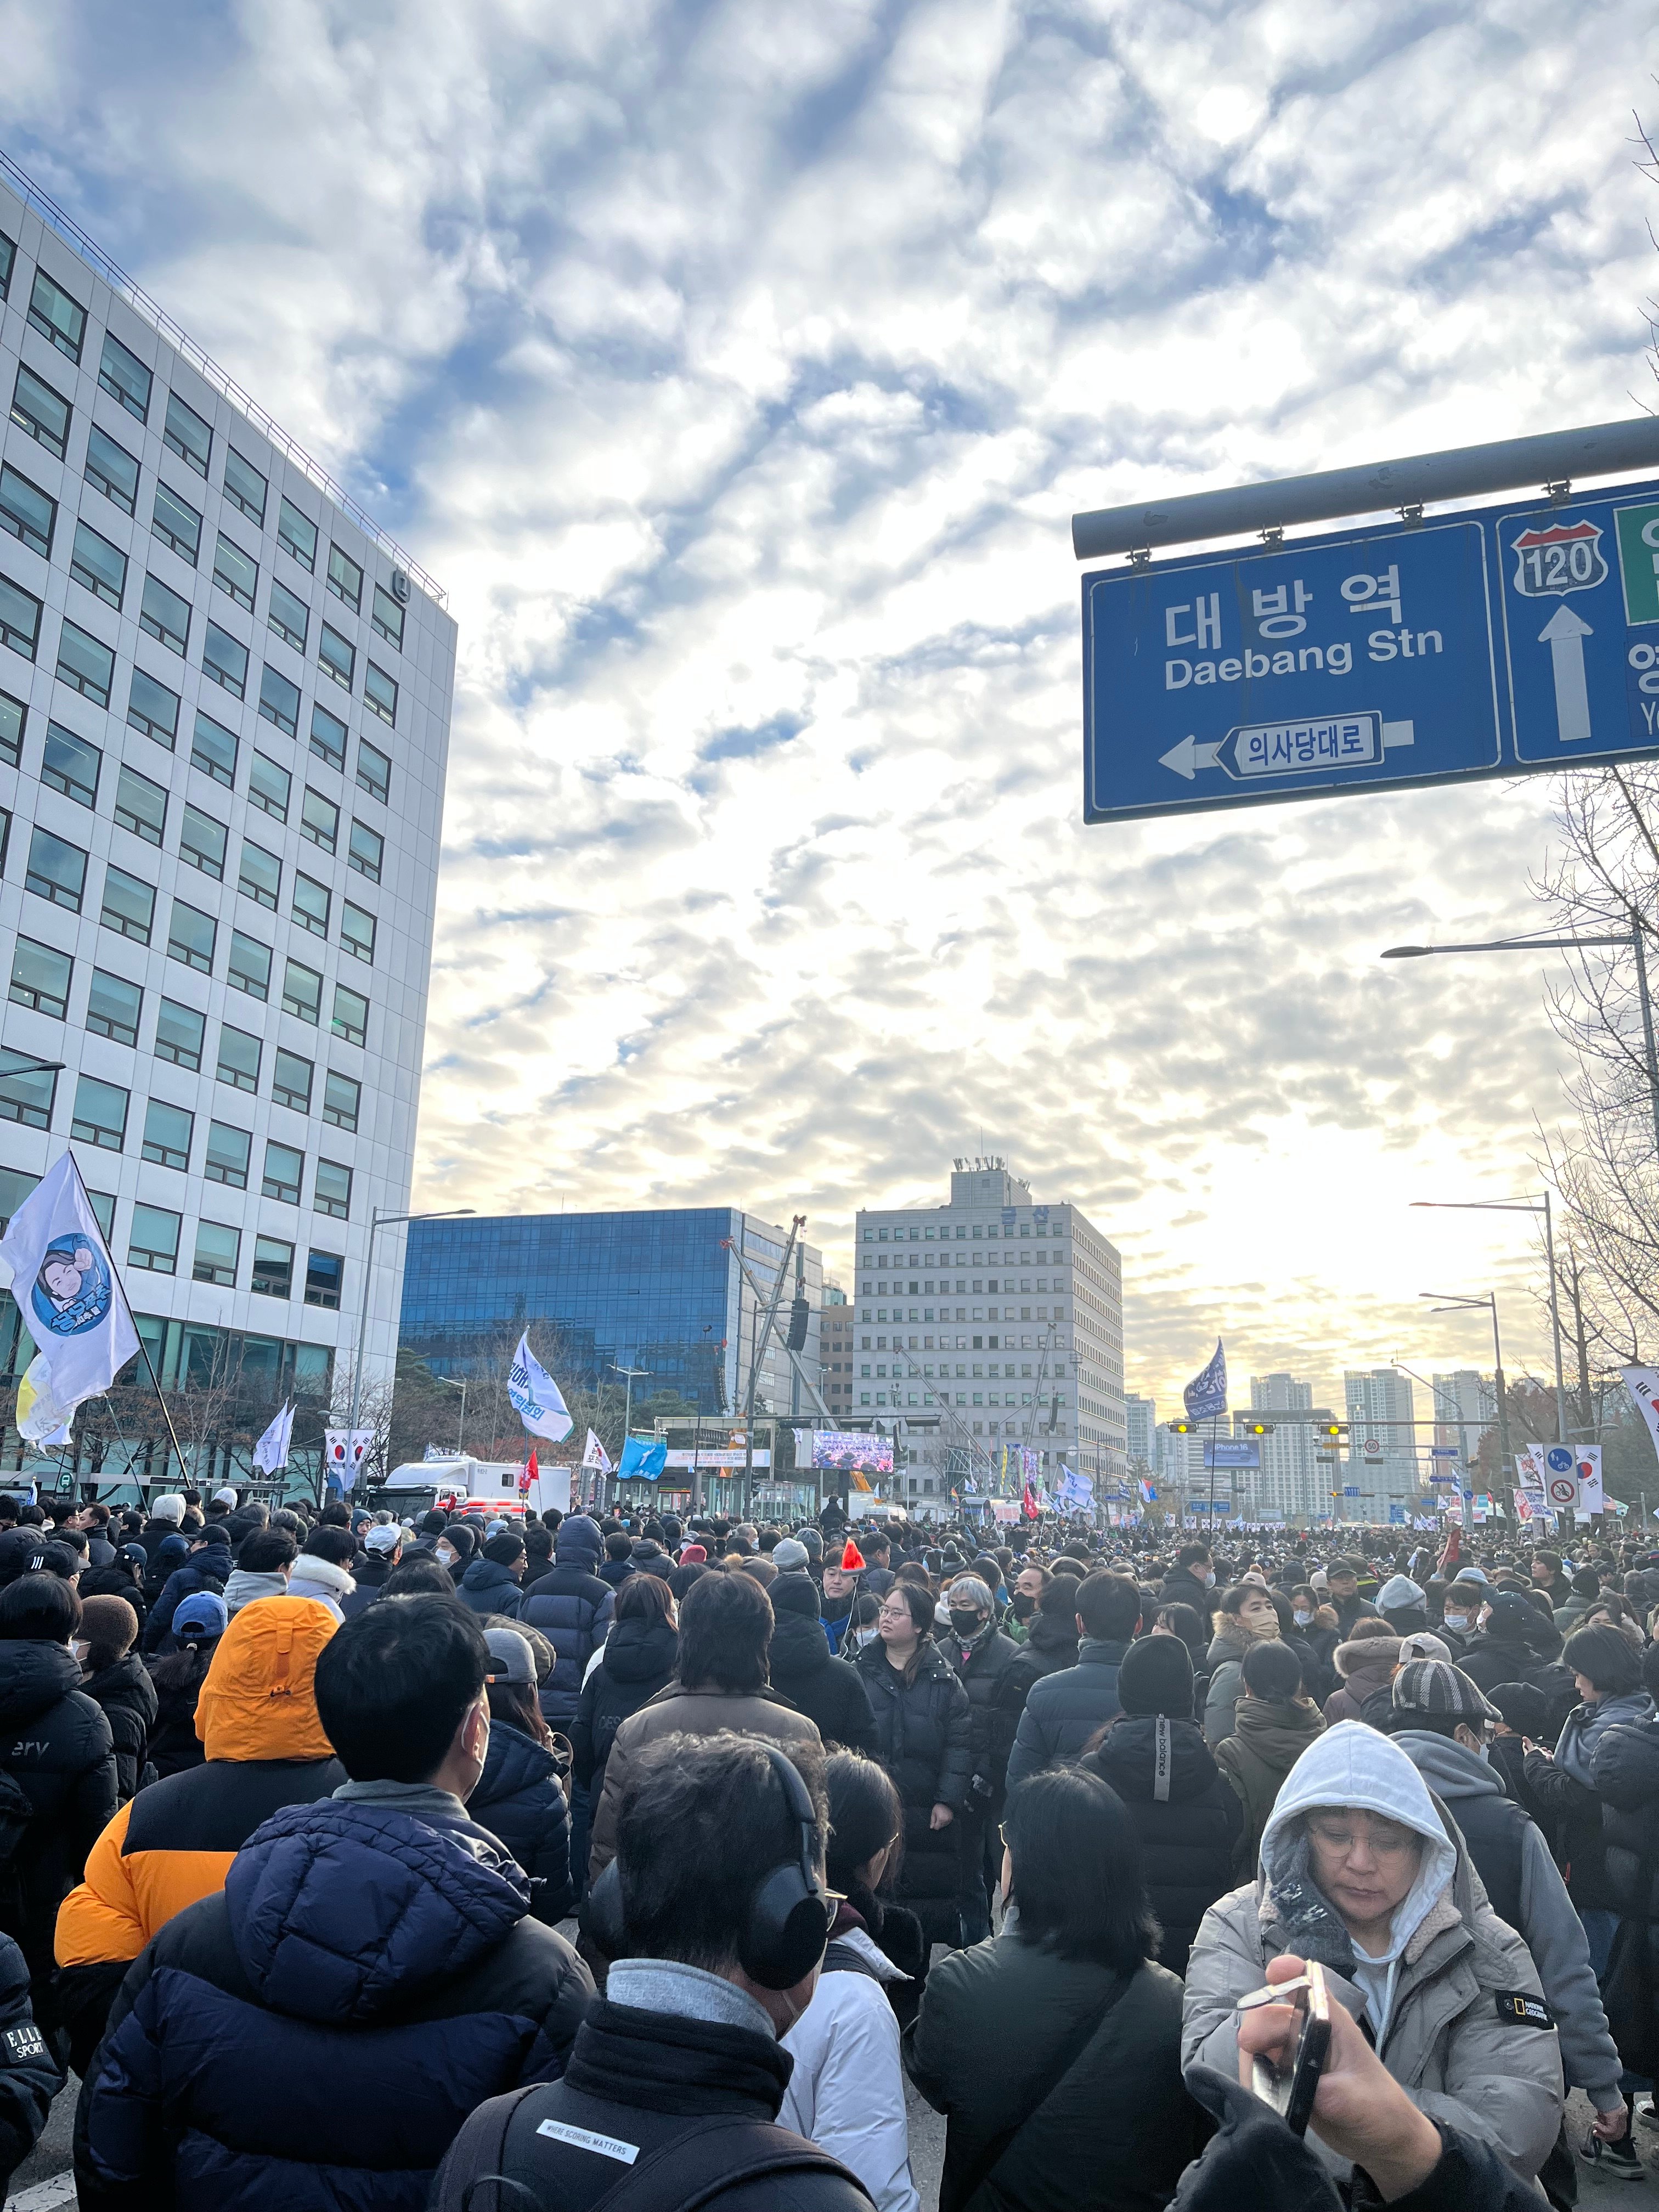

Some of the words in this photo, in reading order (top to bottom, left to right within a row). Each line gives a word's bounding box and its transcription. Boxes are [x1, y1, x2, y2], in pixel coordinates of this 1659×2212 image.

[1527, 541, 1592, 589] 120
[1165, 641, 1353, 691] Daebang
[1368, 628, 1444, 662] Stn
[1248, 721, 1364, 767] 의사당대로
[1159, 1739, 1167, 1777] balance
[6, 2027, 42, 2048] ELLE
[16, 2042, 44, 2058] SPORT
[546, 2125, 565, 2136] WHERE
[565, 2129, 592, 2143] SCORING
[592, 2138, 627, 2155] MATTERS
